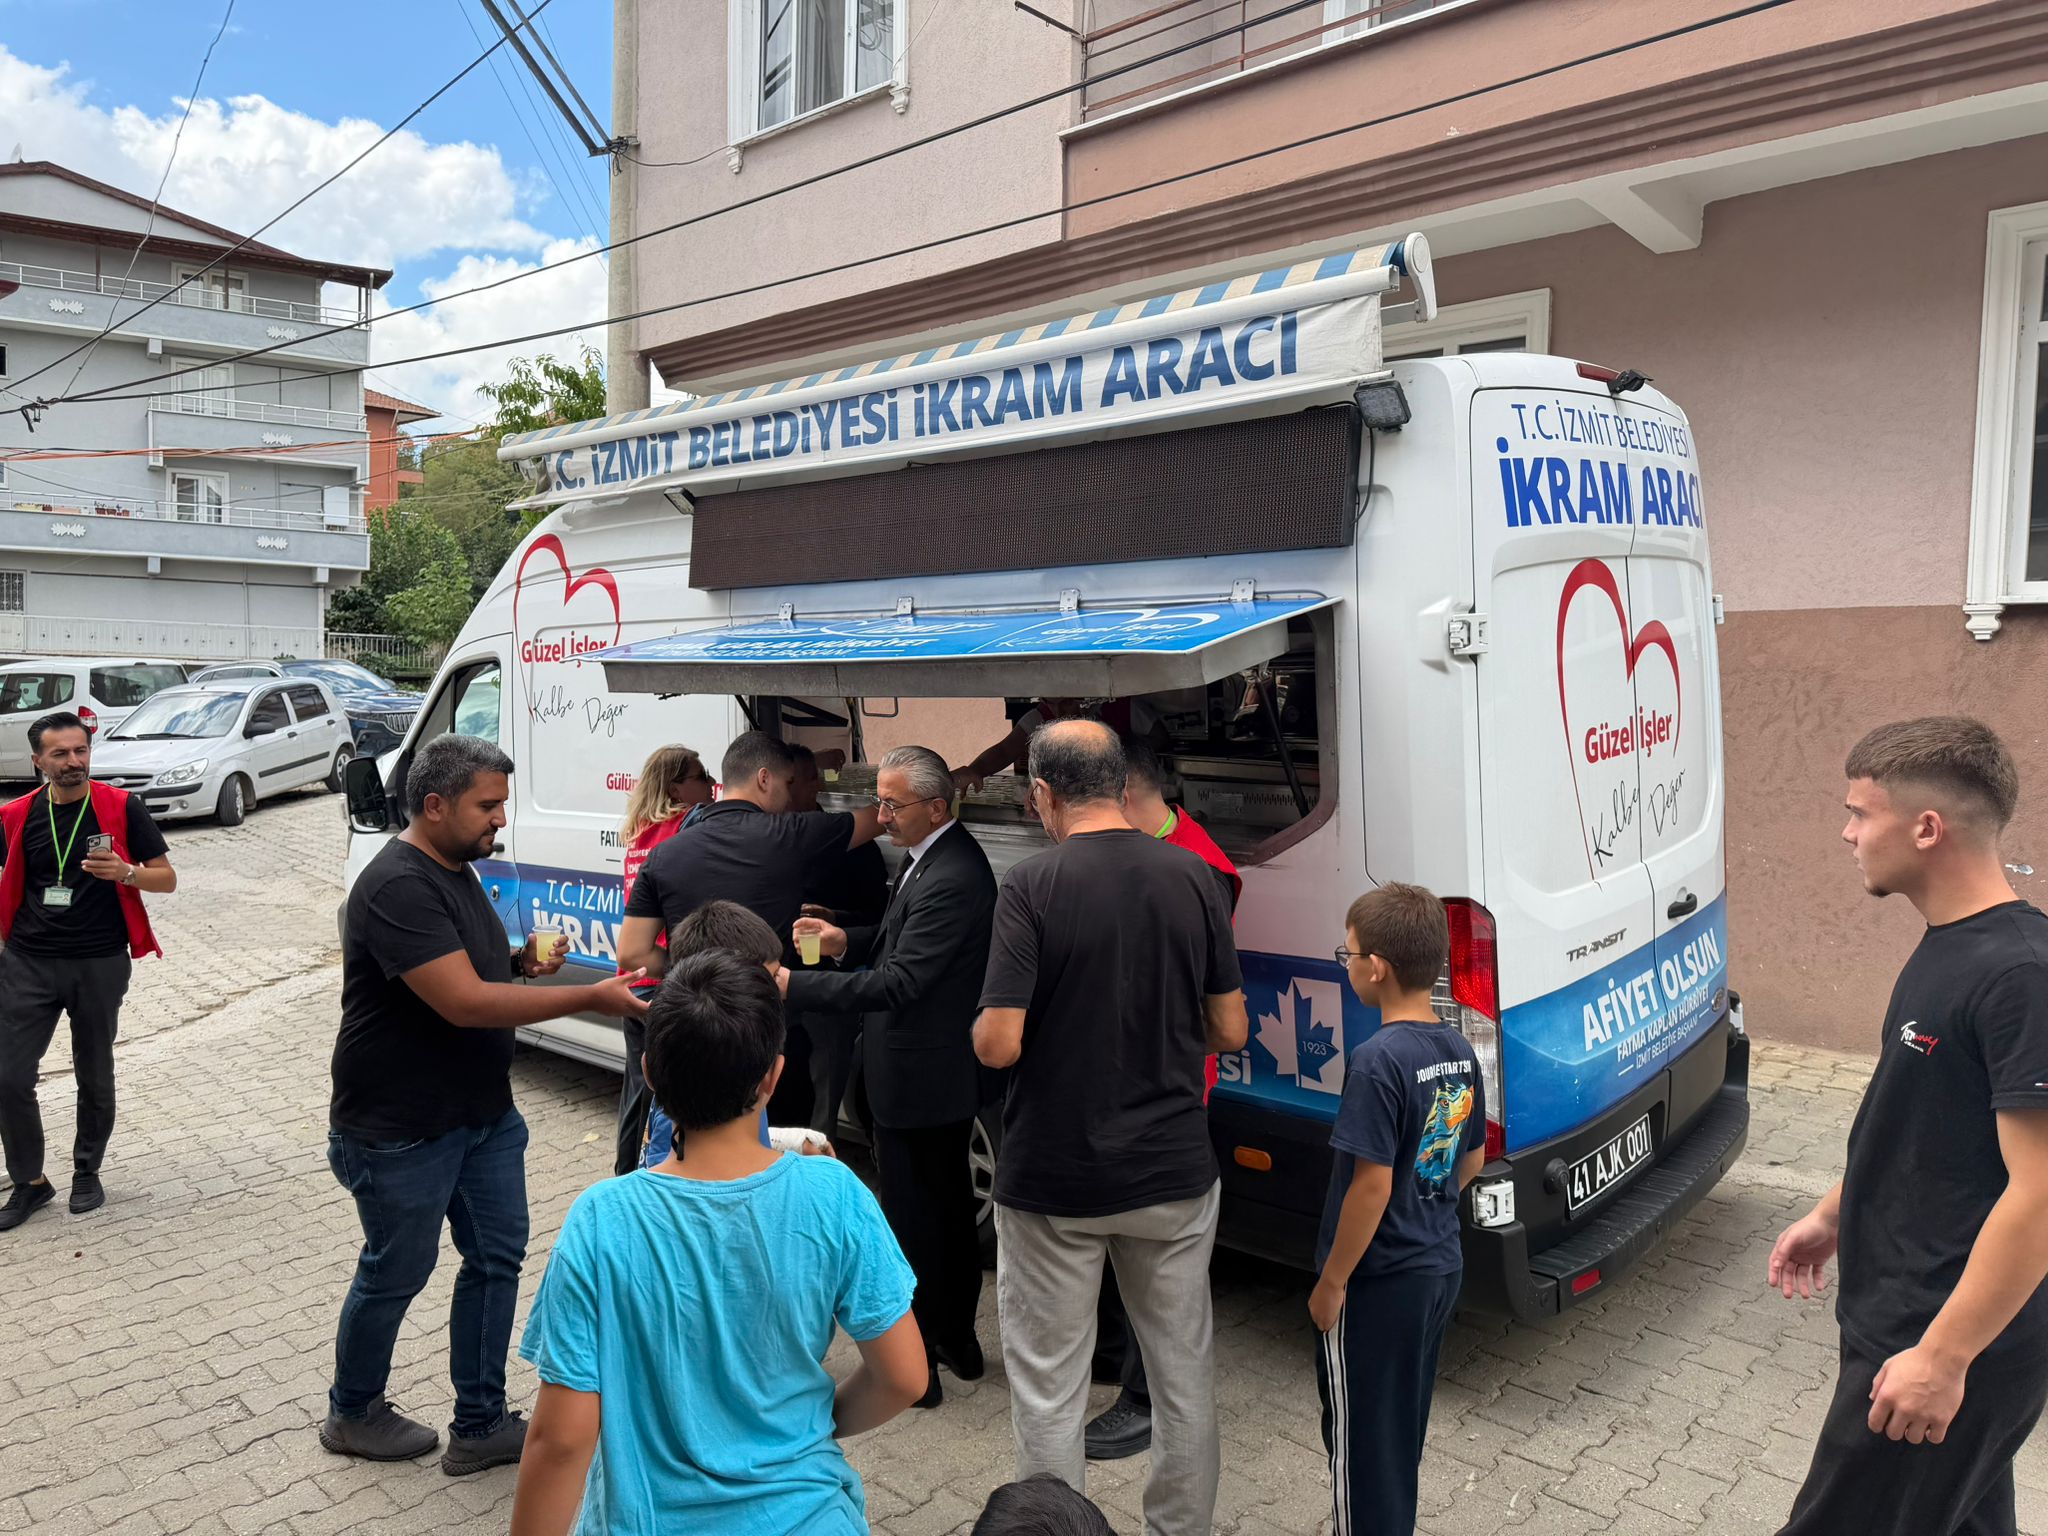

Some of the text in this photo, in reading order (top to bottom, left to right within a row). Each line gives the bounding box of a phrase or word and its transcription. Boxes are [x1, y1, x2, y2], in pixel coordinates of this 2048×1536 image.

[591, 433, 679, 486] İZMİT
[688, 389, 898, 471] BELEDİYESİ
[914, 356, 1083, 438] İKRAM
[1100, 311, 1298, 408] ARACI
[1613, 415, 1691, 459] BELEDİYESİ
[1496, 436, 1704, 530] İKRAM ARACI
[521, 637, 566, 664] Güzel
[532, 685, 629, 737] Kalbe Değer
[1584, 705, 1673, 764] Güzel İşler
[578, 877, 625, 915] İZMİ
[1566, 927, 1627, 962] TRANSIT
[1583, 927, 1721, 1052] AFİYET OLSUN
[1302, 1040, 1327, 1056] 1923
[1617, 1029, 1647, 1064] FATMA
[1647, 1009, 1678, 1043] KAPLAN
[1574, 1121, 1649, 1200] 41 AJK 001
